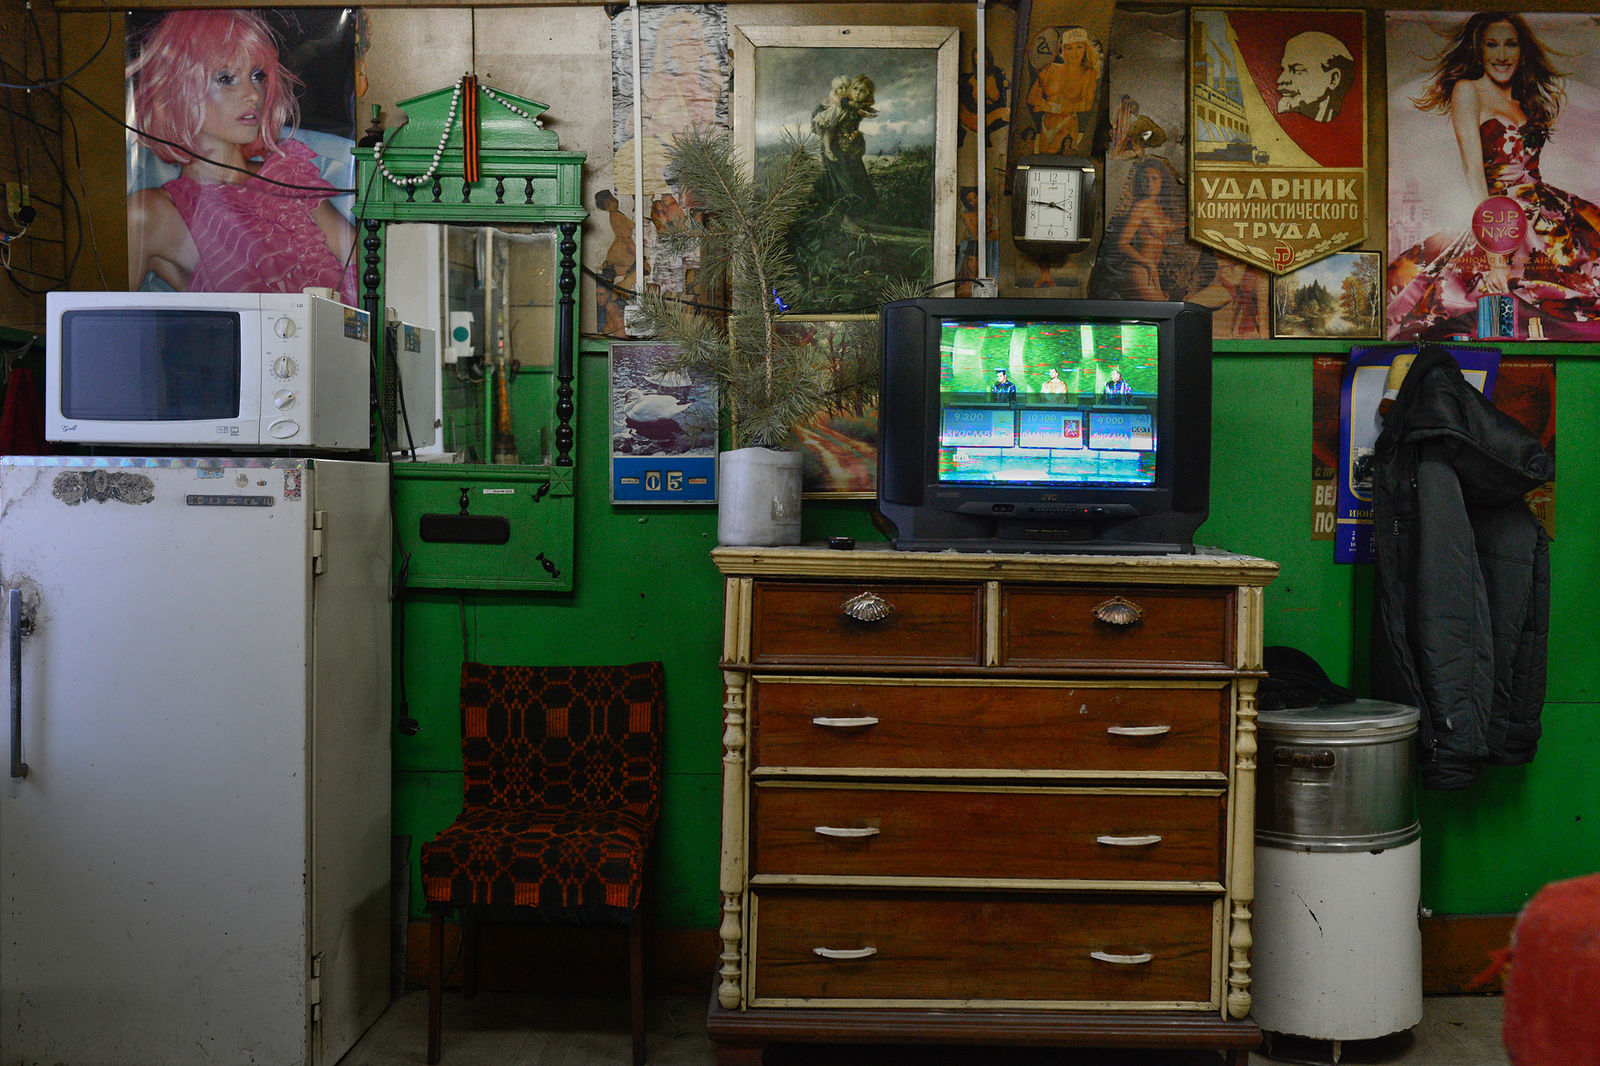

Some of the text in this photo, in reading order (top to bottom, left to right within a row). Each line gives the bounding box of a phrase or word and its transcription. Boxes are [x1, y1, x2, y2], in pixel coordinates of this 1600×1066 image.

[1049, 172, 1058, 183] 12
[1030, 187, 1074, 198] 10 2
[1200, 177, 1358, 200] УДАРНИК
[1068, 201, 1073, 211] 3
[1197, 202, 1359, 220] КОММУНИСТИЧЕСКОГО
[1030, 211, 1072, 221] 8 4
[1482, 210, 1519, 224] SJP
[1033, 227, 1069, 237] 7 6 5
[1233, 222, 1322, 240] ТРУДА
[1481, 226, 1520, 239] NYC
[1323, 467, 1336, 478] ПР
[1315, 512, 1336, 533] ПО
